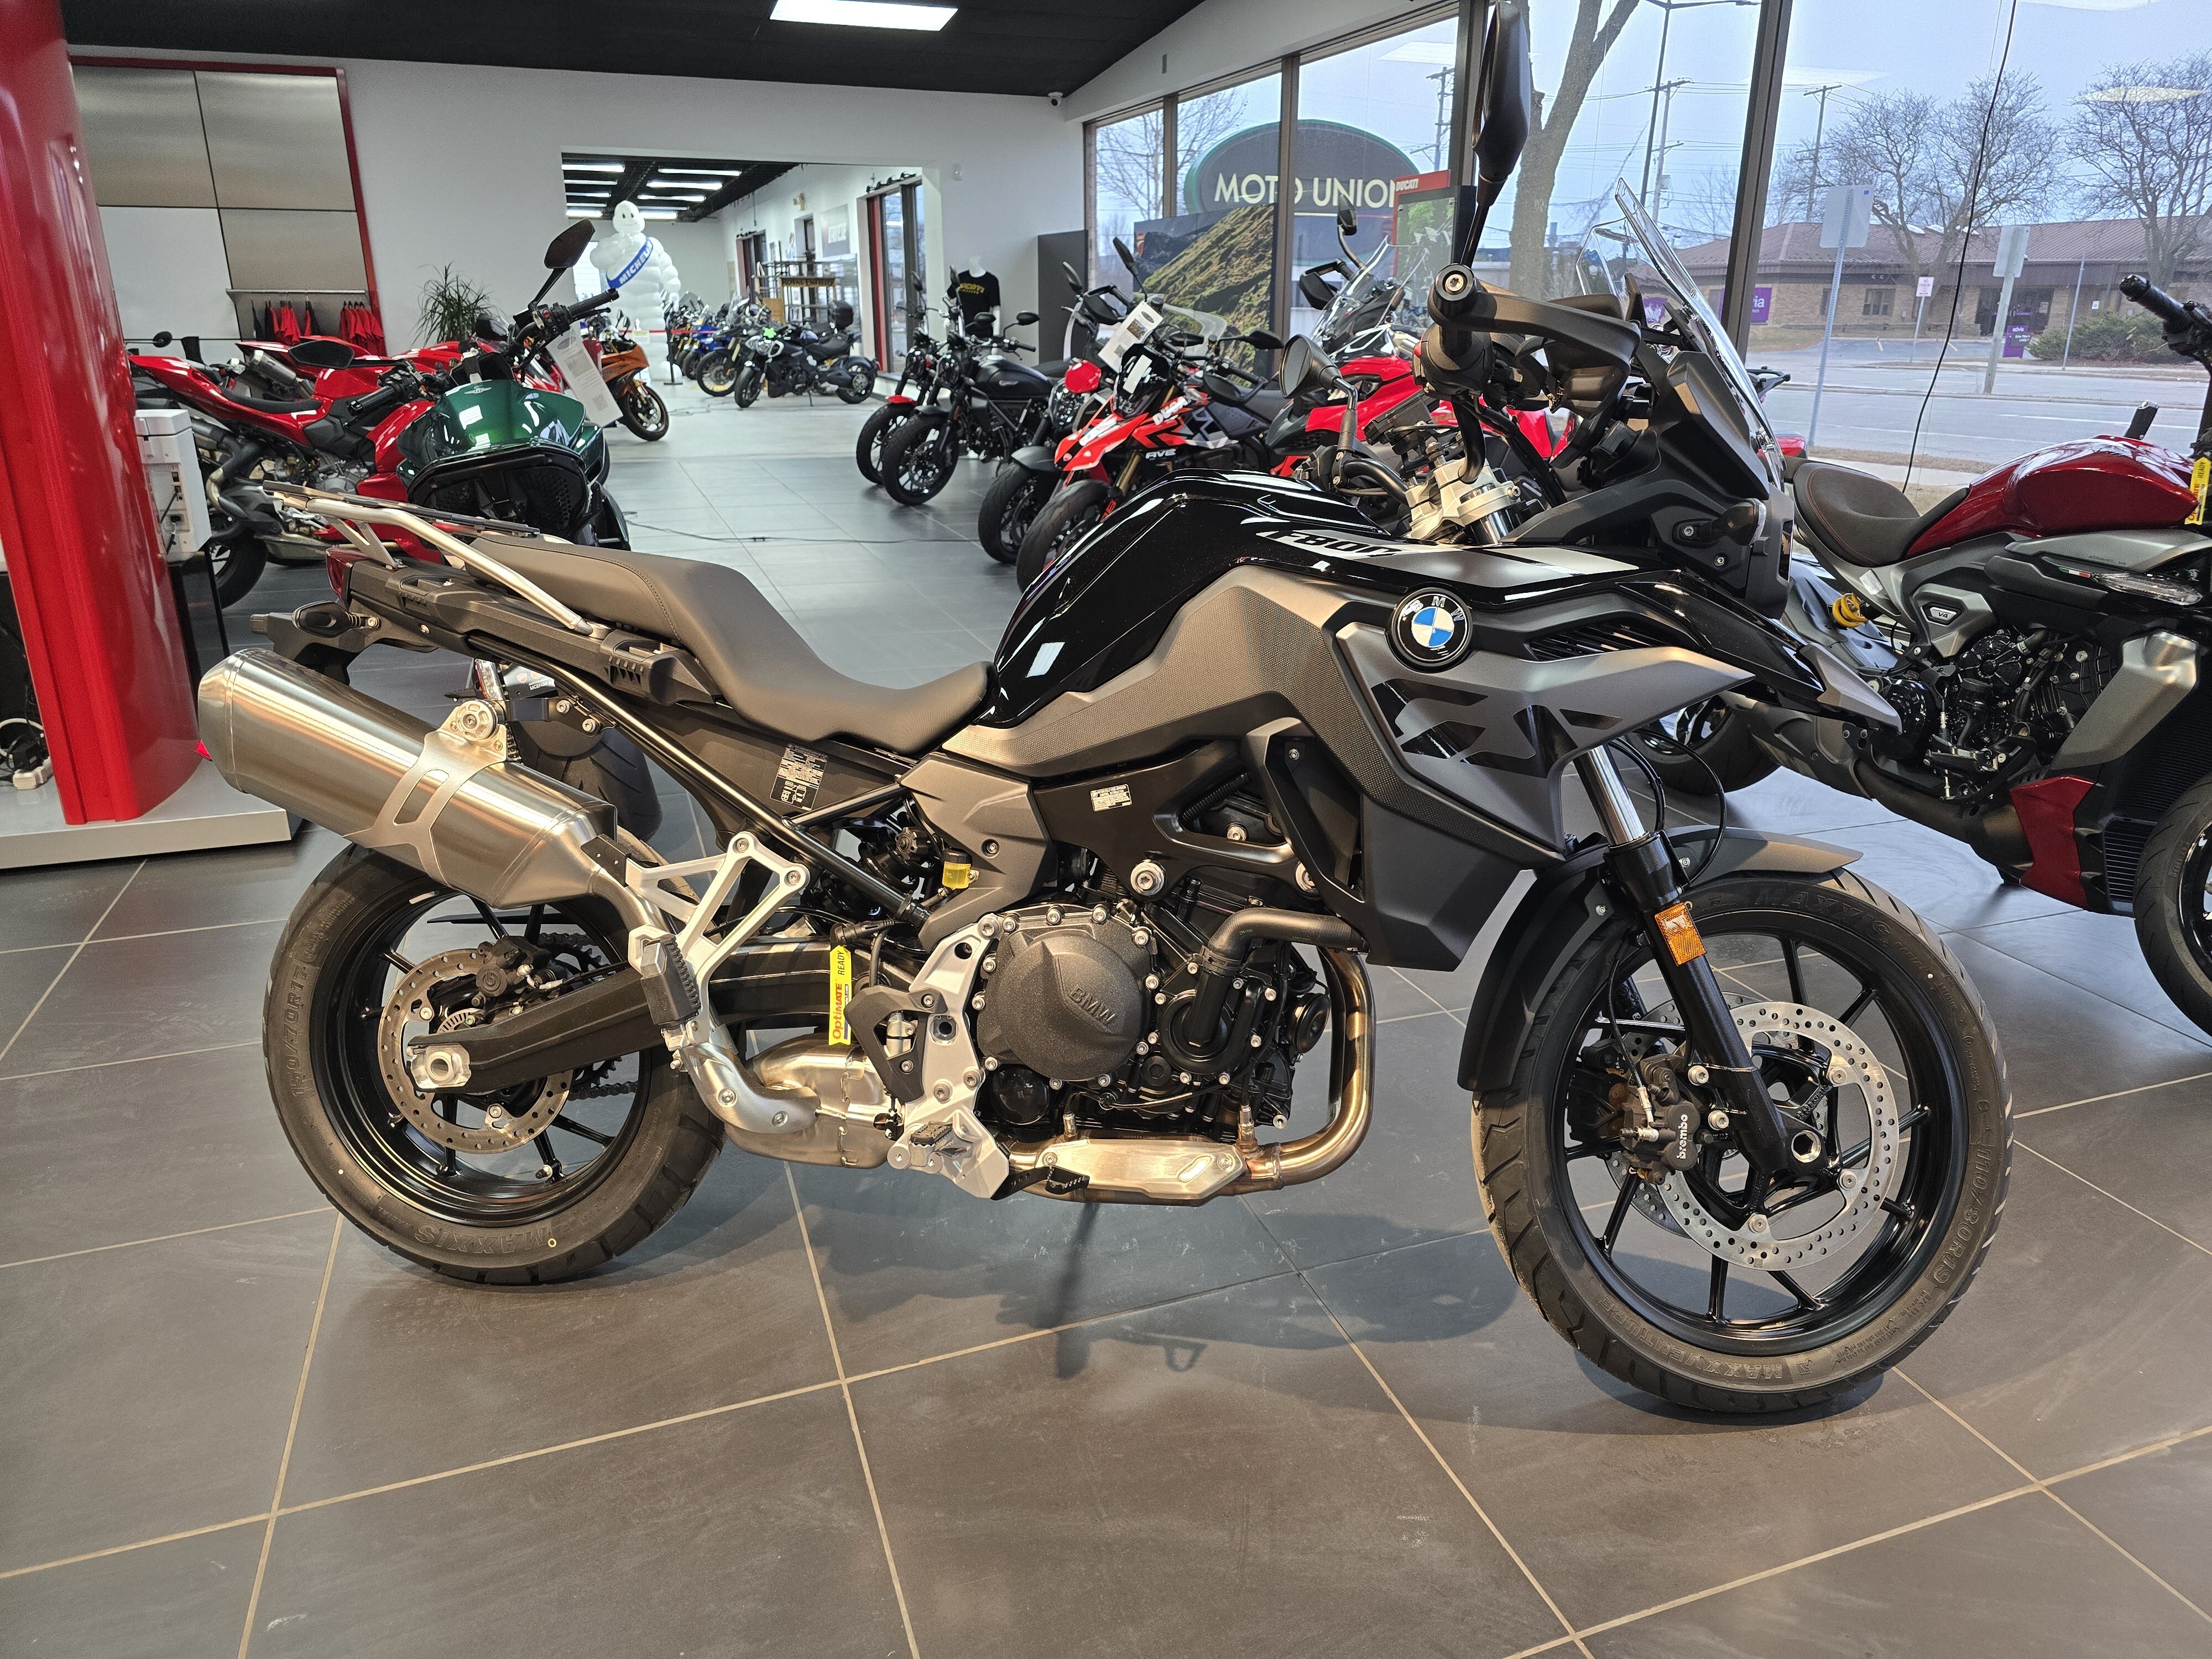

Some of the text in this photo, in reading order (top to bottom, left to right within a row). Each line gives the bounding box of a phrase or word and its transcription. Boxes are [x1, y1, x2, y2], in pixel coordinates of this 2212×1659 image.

[1396, 178, 1420, 192] DUCATI
[2198, 461, 2206, 479] READY
[1408, 596, 1464, 622] BMW
[832, 983, 844, 1040] OptiMATE
[1069, 984, 1118, 1024] BMW
[284, 964, 307, 1098] 150/70R17
[1676, 1114, 1688, 1159] brembo
[1934, 1149, 1991, 1284] 110/80R19
[414, 1223, 551, 1254] MAXXIS
[1599, 1295, 1783, 1380] MAXXVENTURE
